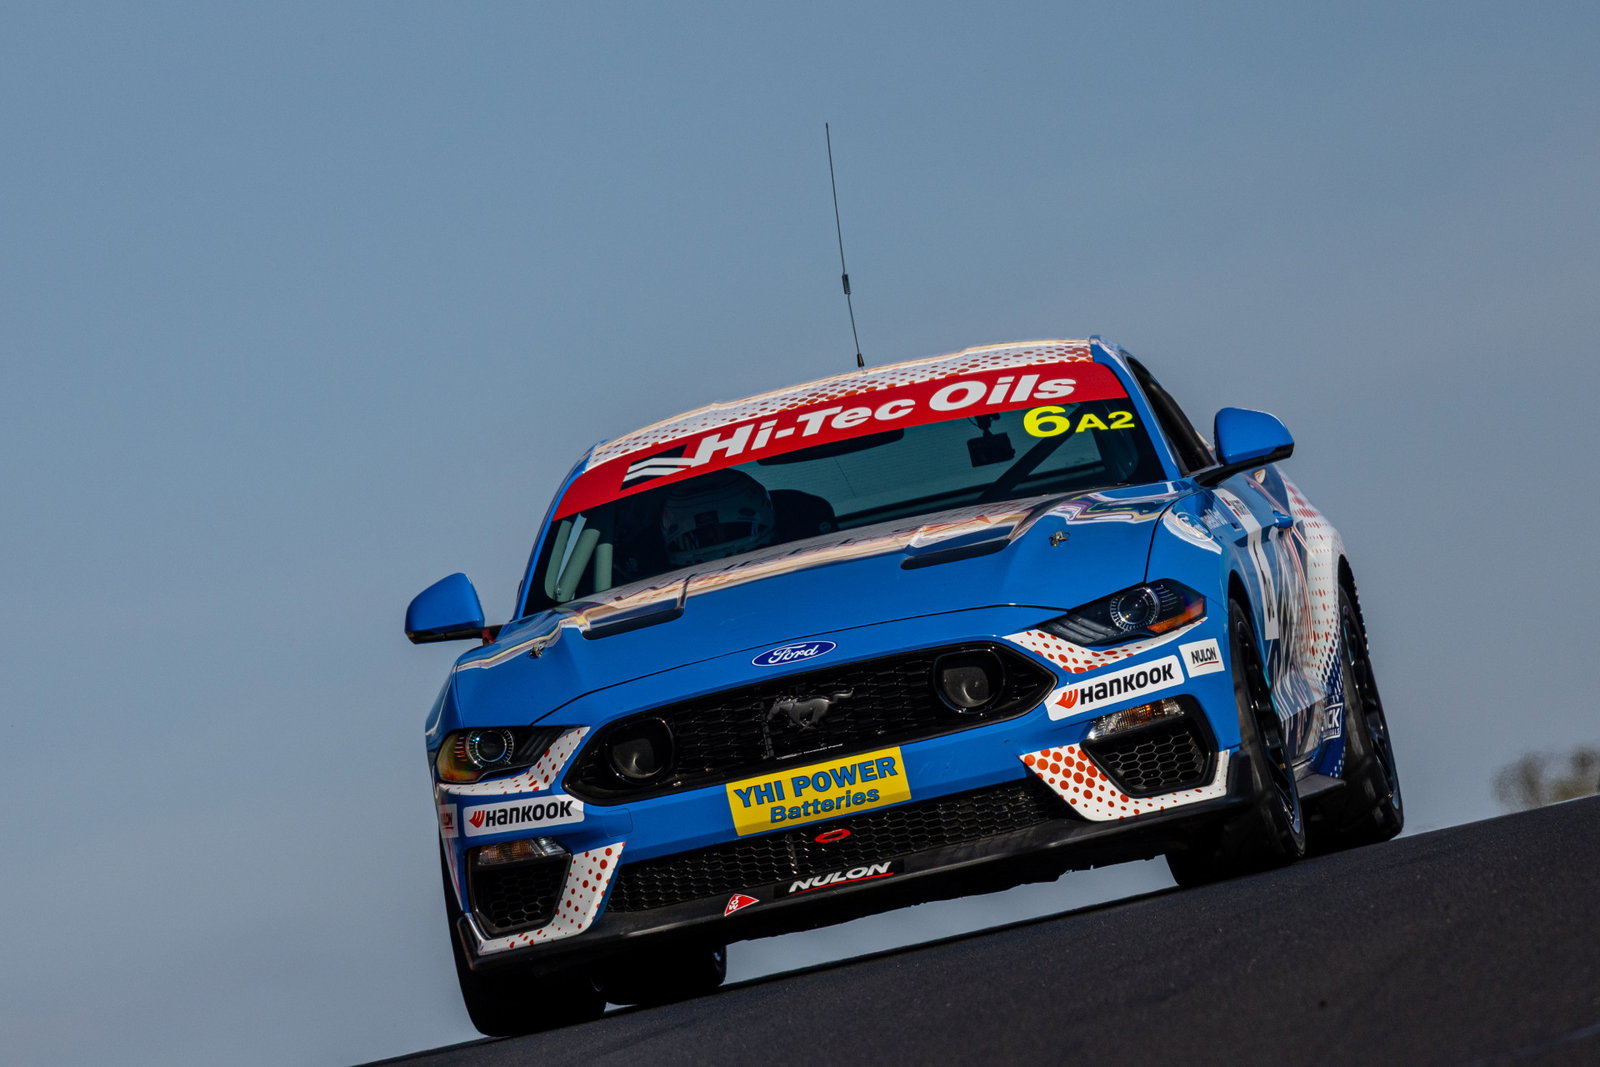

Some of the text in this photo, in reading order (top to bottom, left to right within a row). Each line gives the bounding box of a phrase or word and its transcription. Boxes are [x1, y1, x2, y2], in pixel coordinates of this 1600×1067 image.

[691, 374, 1076, 467] Hi-Tec Oils
[1023, 405, 1135, 437] 6 A2
[768, 641, 820, 664] Ford
[1191, 648, 1217, 664] NULON
[734, 756, 898, 807] YHI POWER
[770, 788, 880, 823] Batteries
[788, 861, 892, 893] NULON
